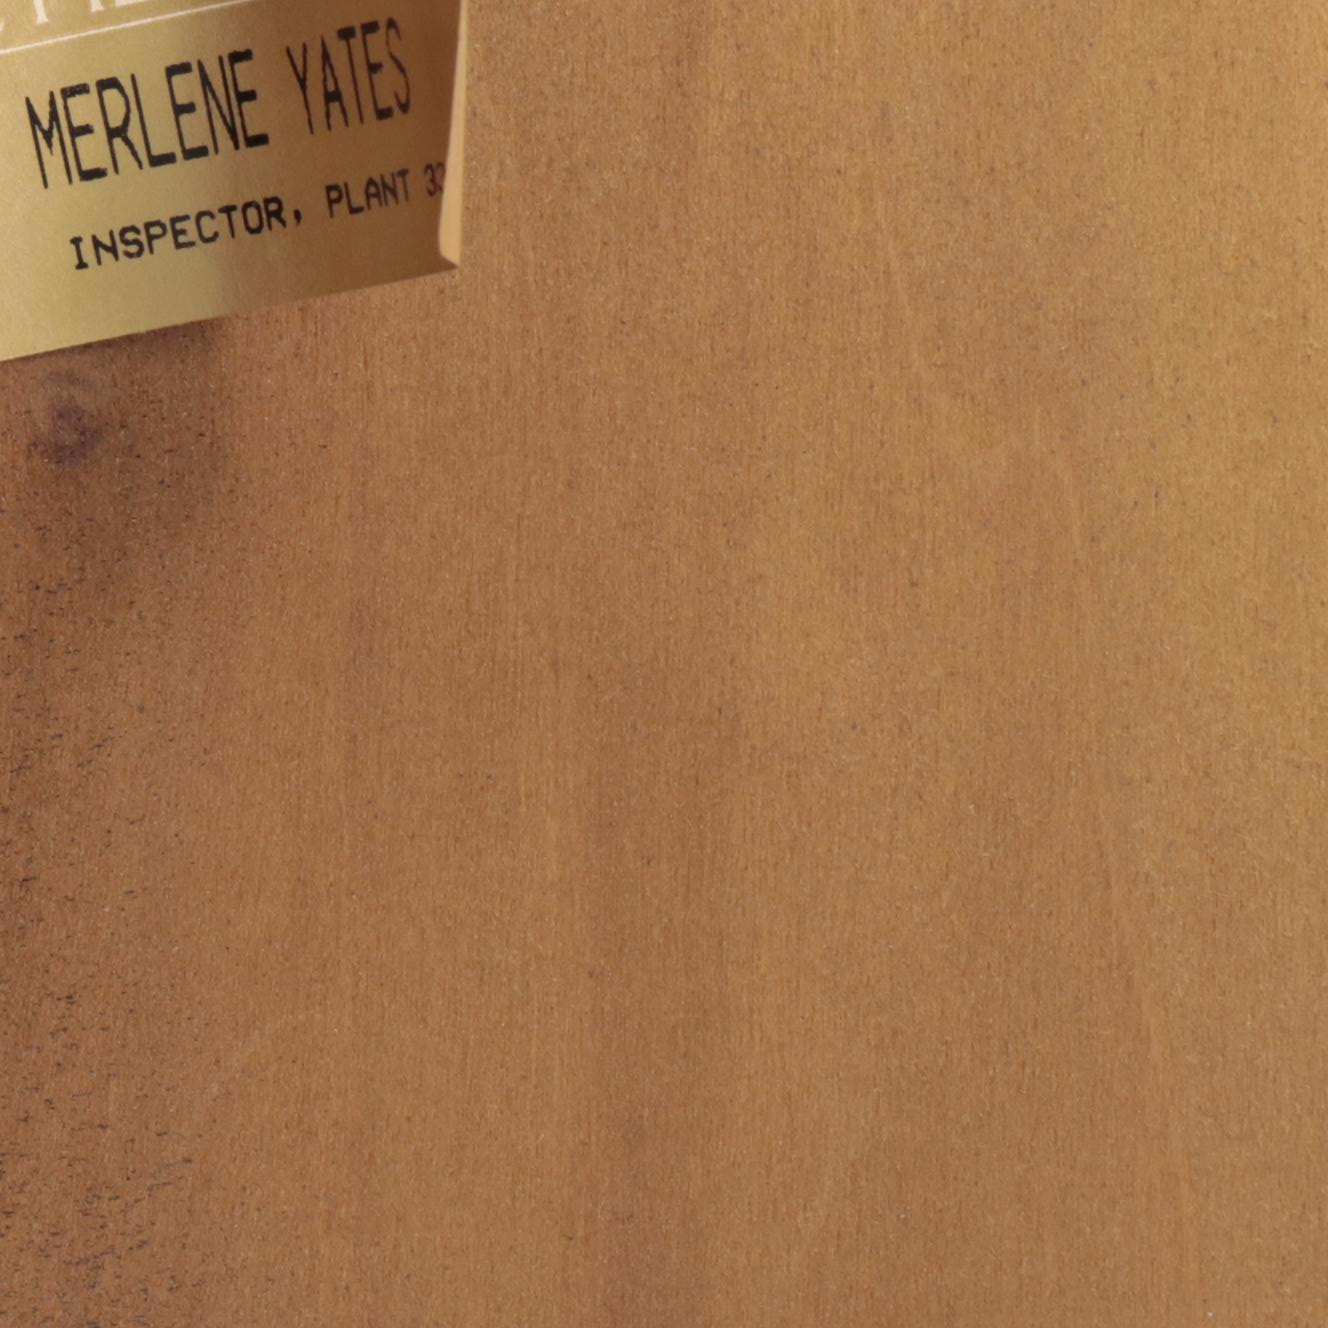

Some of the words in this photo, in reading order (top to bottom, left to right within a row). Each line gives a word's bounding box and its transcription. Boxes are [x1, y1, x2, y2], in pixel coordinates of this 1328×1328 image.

[25, 48, 270, 189] MERLENE
[285, 17, 411, 135] YATES
[70, 195, 303, 271] INSPECTOR,
[325, 168, 410, 219] PLANT
